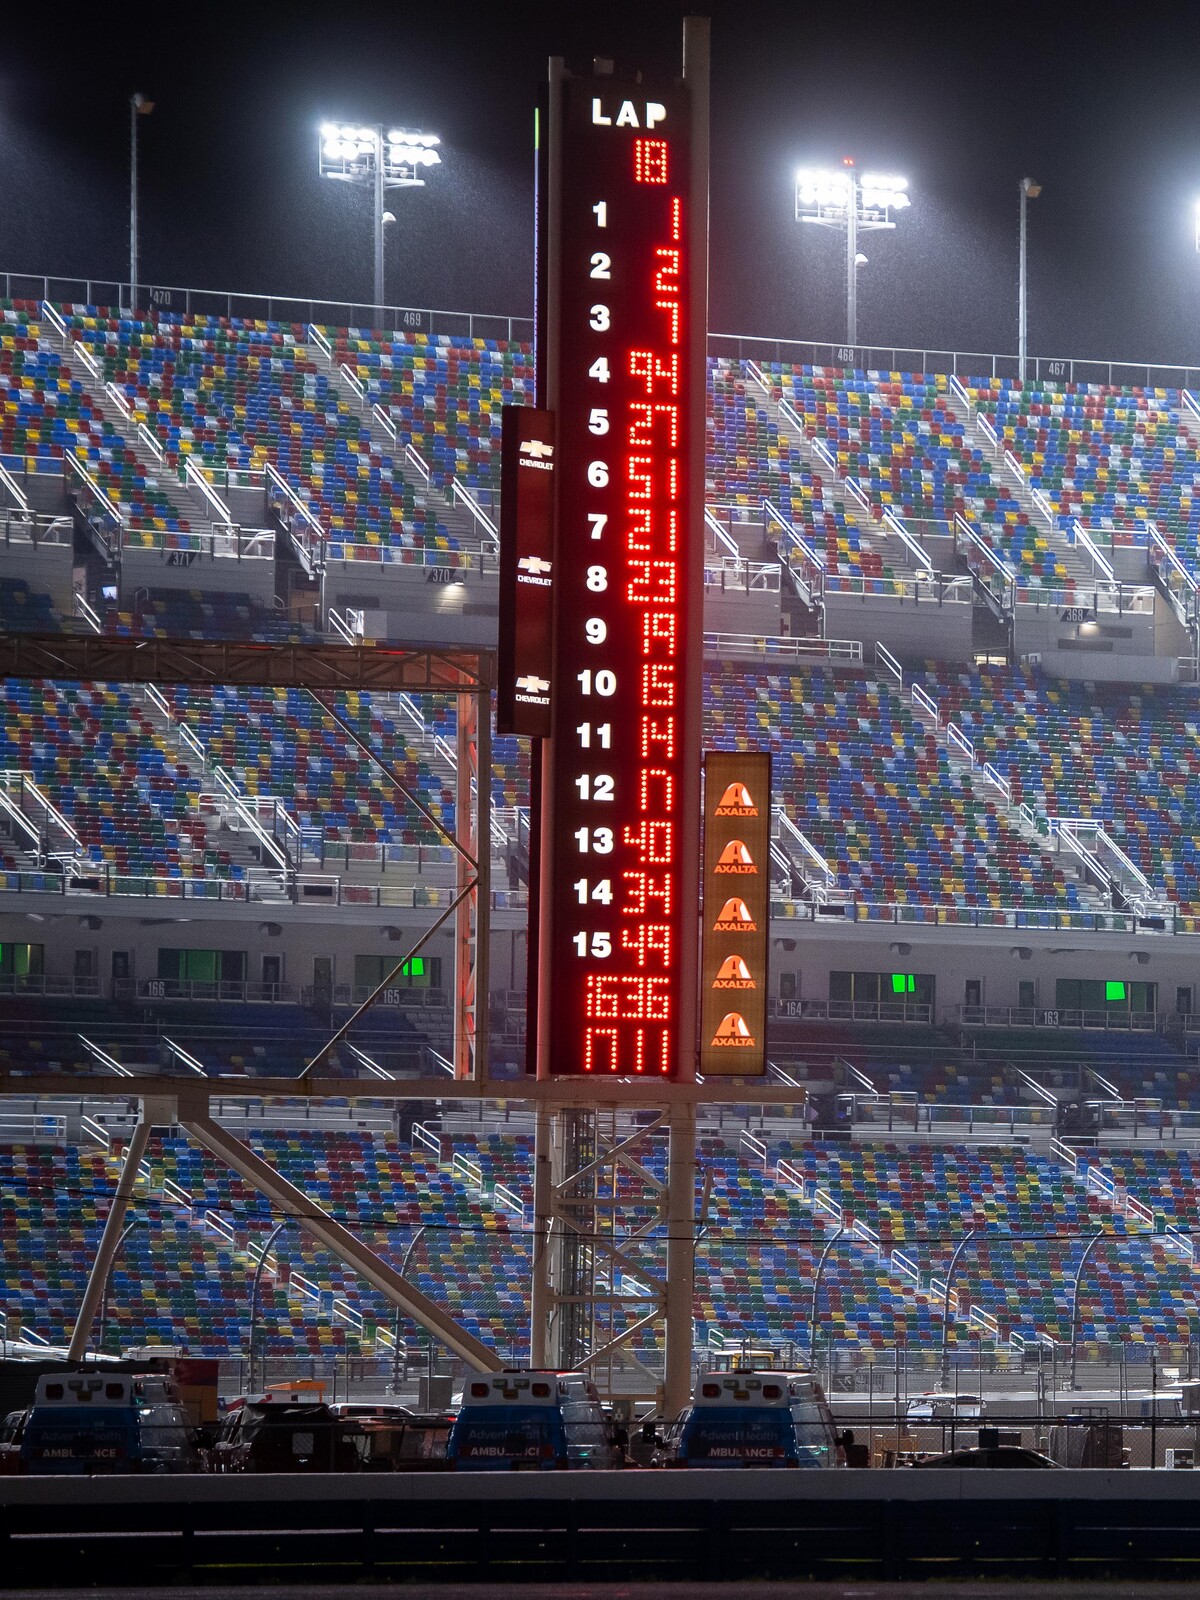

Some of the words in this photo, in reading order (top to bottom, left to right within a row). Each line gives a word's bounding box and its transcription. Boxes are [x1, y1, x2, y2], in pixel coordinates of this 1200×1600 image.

[592, 98, 667, 129] LAP
[635, 139, 667, 184] 18
[592, 201, 606, 228] 1
[671, 197, 681, 241] 1
[590, 252, 611, 279] 2
[655, 248, 680, 293] 2
[153, 291, 171, 304] 470
[404, 313, 421, 326] 469
[589, 304, 610, 332] 3
[655, 300, 680, 345] 7
[838, 348, 854, 361] 468
[588, 357, 611, 384] 4
[629, 350, 680, 396] 94
[1048, 363, 1064, 375] 467
[588, 408, 610, 435] 5
[628, 402, 679, 448] 27
[519, 458, 554, 470] CHEVROLET
[587, 461, 609, 488] 6
[627, 455, 679, 500] 51
[587, 513, 608, 540] 7
[627, 507, 678, 552] 21
[433, 569, 450, 582] 370
[517, 574, 552, 586] CHEVROLET
[586, 565, 608, 593] 8
[627, 559, 677, 604] 23
[1066, 608, 1083, 621] 368
[585, 617, 607, 645] 9
[643, 612, 676, 655] 19
[577, 669, 617, 697] 10
[642, 663, 675, 707] 15
[515, 693, 550, 705] CHEVROLET
[576, 722, 612, 749] 11
[641, 715, 675, 759] 14
[575, 774, 615, 802] 12
[714, 808, 758, 817] AXALTA
[574, 826, 614, 854] 13
[623, 820, 673, 864] 40
[714, 865, 758, 874] AXALTA
[573, 878, 613, 905] 14
[622, 871, 672, 915] 34
[713, 922, 757, 931] AXALTA
[572, 931, 612, 958] 15
[622, 924, 672, 967] 49
[148, 981, 165, 996] 166
[712, 980, 756, 989] AXALTA
[383, 989, 399, 1004] 165
[786, 1001, 802, 1015] 164
[1044, 1011, 1059, 1025] 163
[711, 1037, 755, 1046] AXALTA
[42, 1448, 116, 1458] AMBNCE
